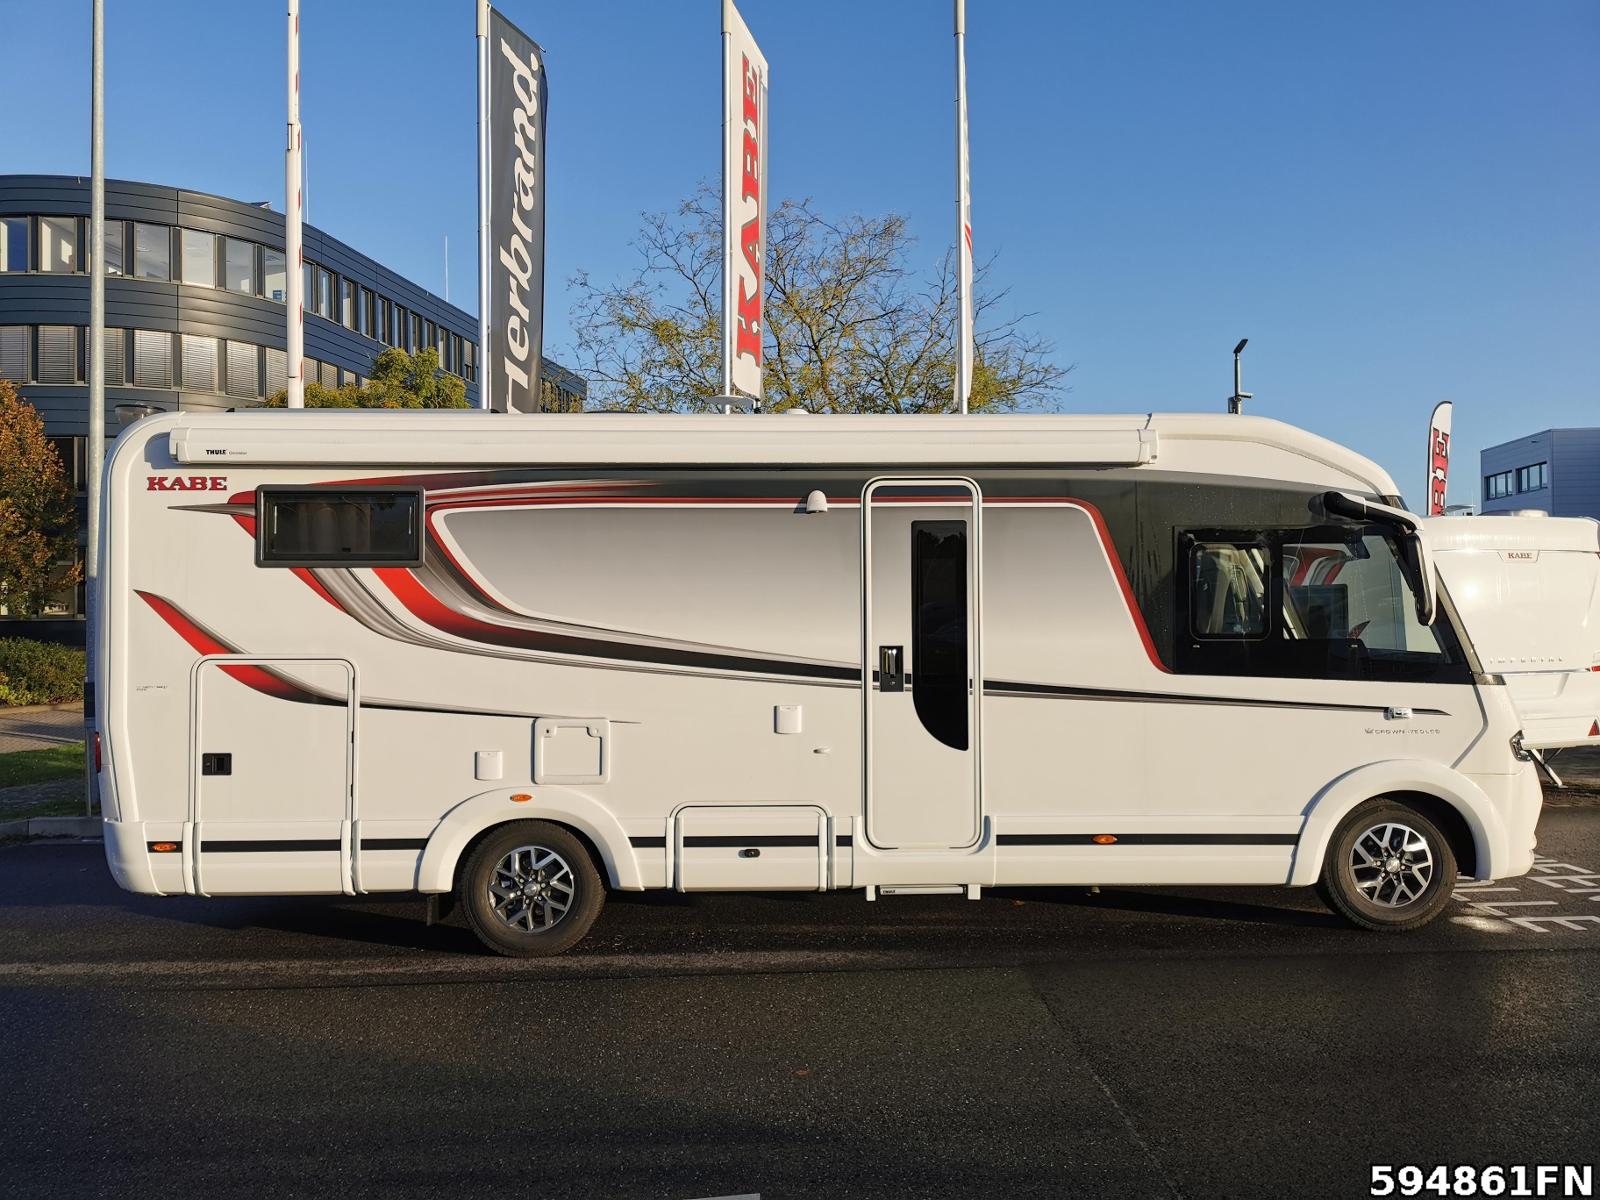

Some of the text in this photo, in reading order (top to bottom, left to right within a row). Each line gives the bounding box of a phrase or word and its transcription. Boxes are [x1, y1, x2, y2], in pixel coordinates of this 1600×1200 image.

[736, 50, 762, 368] KABE
[146, 476, 228, 491] KABE
[1430, 427, 1450, 516] BE
